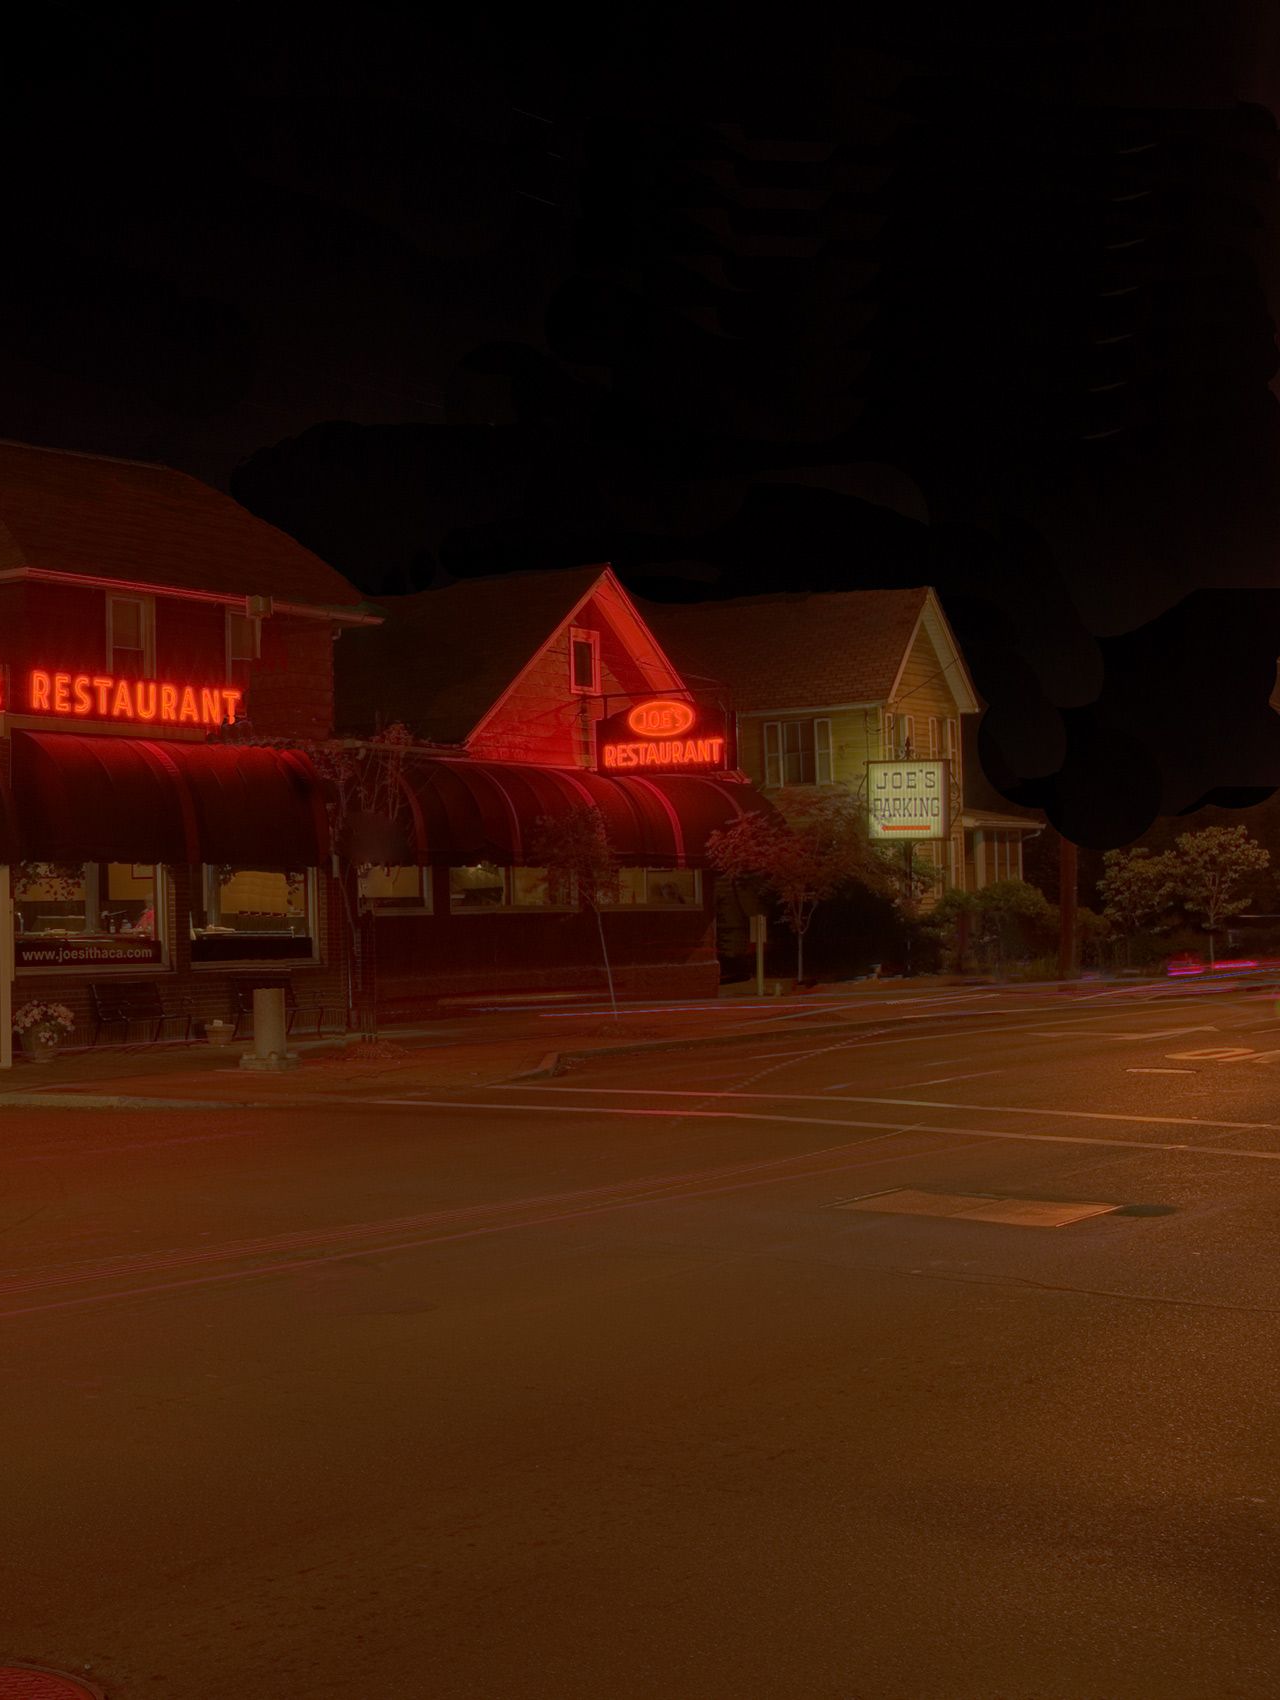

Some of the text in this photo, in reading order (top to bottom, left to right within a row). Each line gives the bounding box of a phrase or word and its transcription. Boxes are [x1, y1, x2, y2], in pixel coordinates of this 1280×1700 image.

[30, 669, 243, 726] RESTAURANT
[603, 737, 724, 768] RESTAURANT
[876, 768, 936, 790] JOE'S
[872, 796, 940, 818] PARKING
[22, 947, 153, 963] www.joesithaca.com
